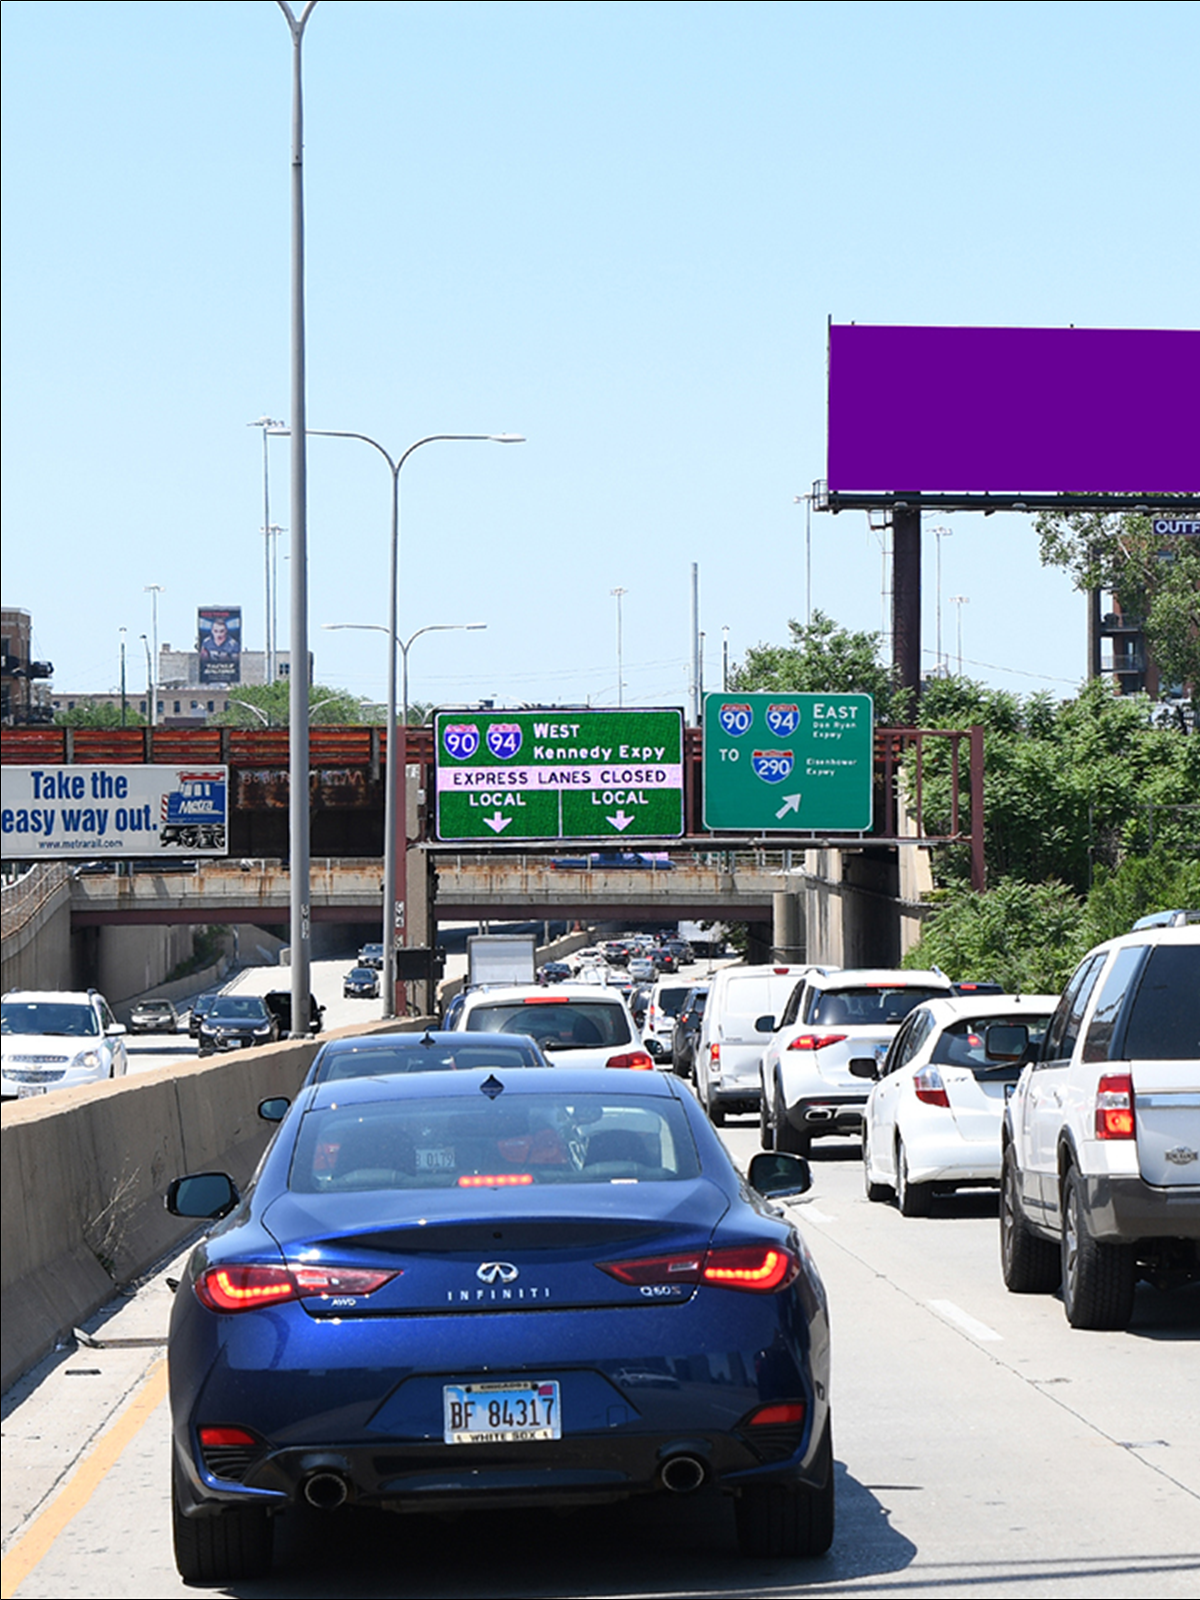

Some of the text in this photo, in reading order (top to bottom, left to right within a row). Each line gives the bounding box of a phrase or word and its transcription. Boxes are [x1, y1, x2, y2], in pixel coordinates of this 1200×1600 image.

[813, 703, 858, 719] EAST
[722, 711, 749, 731] 90
[769, 711, 794, 731] 94
[533, 723, 580, 738] WEST
[447, 734, 475, 752] 90
[490, 734, 516, 752] 94
[533, 745, 665, 761] Kennedy Expy
[719, 749, 740, 762] TO
[758, 760, 790, 776] 290
[31, 771, 128, 799] Take the
[453, 770, 667, 785] EXPRESS LANES CLOSED
[469, 793, 527, 806] LOCAL
[592, 791, 649, 804] LOCAL
[178, 799, 214, 815] Metra
[1, 804, 158, 836] easy way out.
[331, 1298, 357, 1306] AWD
[447, 1287, 550, 1301] INFINITI
[450, 1398, 555, 1429] BF 84317
[470, 1433, 505, 1442] WHITE
